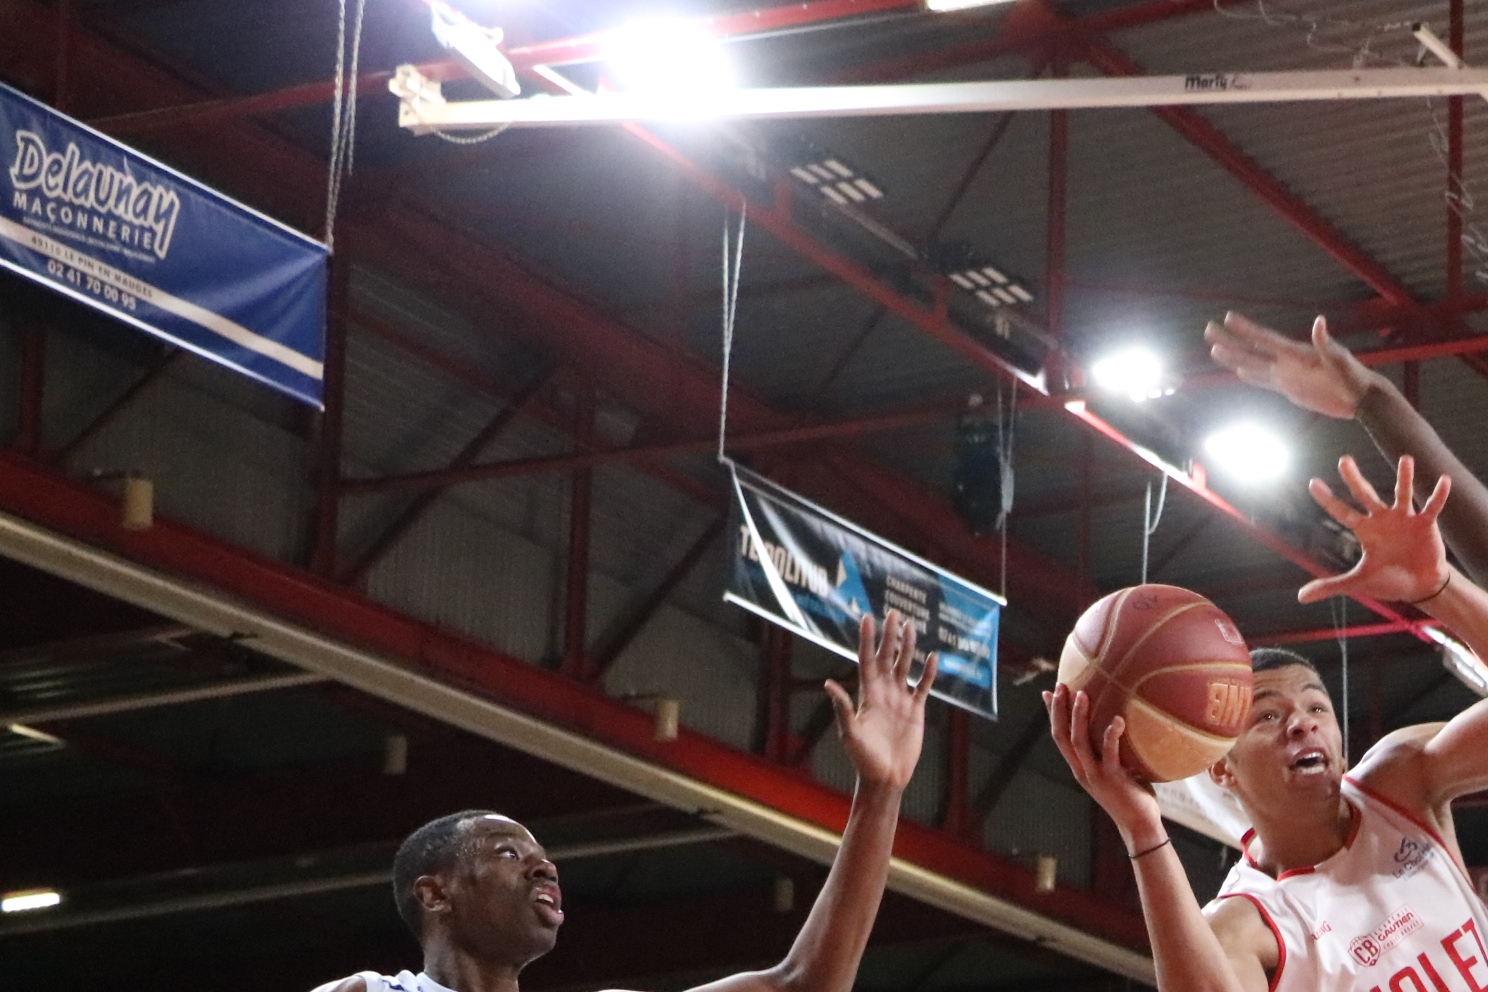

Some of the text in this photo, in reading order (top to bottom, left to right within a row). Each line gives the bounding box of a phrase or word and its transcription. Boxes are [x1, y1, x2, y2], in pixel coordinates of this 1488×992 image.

[10, 130, 181, 260] Delaunay
[13, 192, 152, 249] MAÇONNERIE
[66, 269, 82, 287] 41
